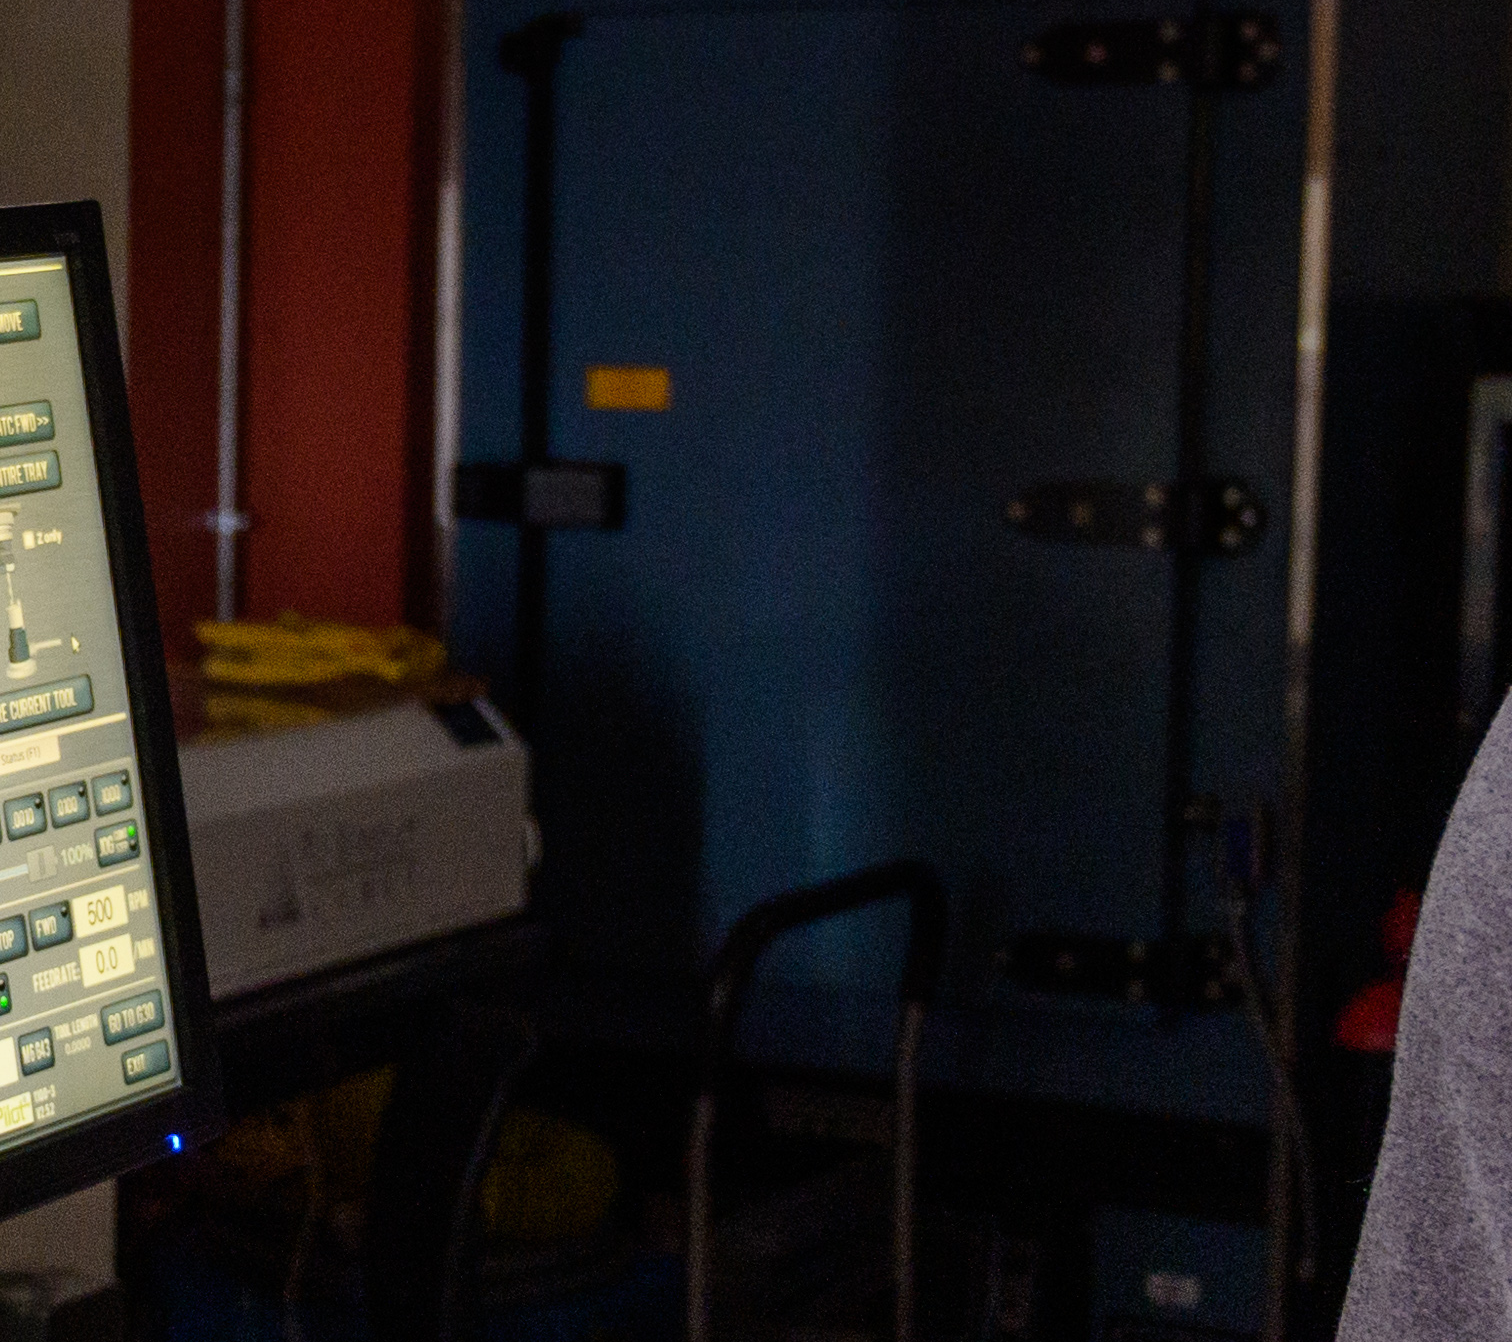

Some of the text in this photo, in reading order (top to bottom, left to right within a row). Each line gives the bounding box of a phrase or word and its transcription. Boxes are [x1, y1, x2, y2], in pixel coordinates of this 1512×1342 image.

[22, 460, 49, 484] TRAY
[8, 691, 53, 721] CURRENT
[52, 686, 78, 710] TOOL
[86, 895, 114, 926] 500
[95, 945, 118, 975] 0.0
